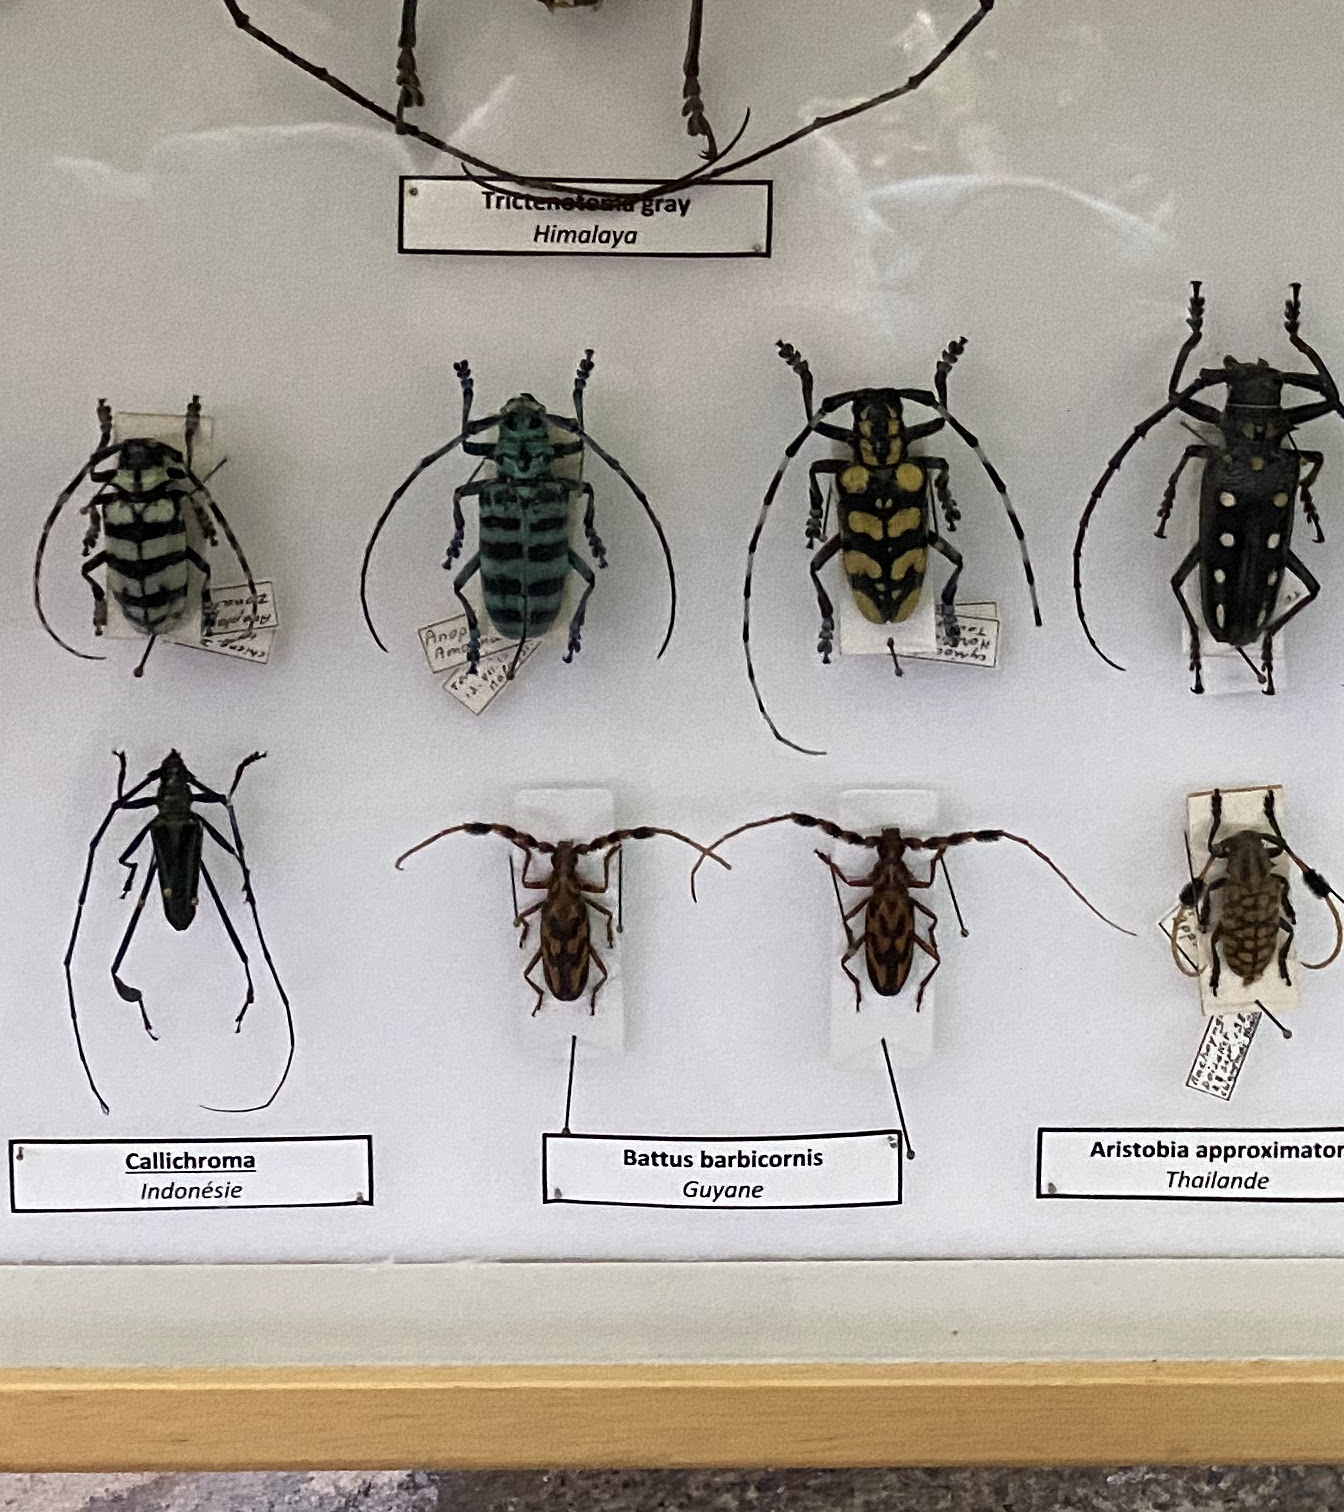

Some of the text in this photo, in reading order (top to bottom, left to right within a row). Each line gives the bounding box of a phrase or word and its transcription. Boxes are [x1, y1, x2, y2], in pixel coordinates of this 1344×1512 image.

[641, 195, 691, 217] gray
[533, 225, 638, 248] Himalaya
[623, 1149, 823, 1168] Battus barbicornis
[1090, 1141, 1189, 1158] Aristobia
[125, 1152, 256, 1174] Callichroma
[141, 1181, 243, 1199] Indonésie
[683, 1181, 764, 1202] Guyane
